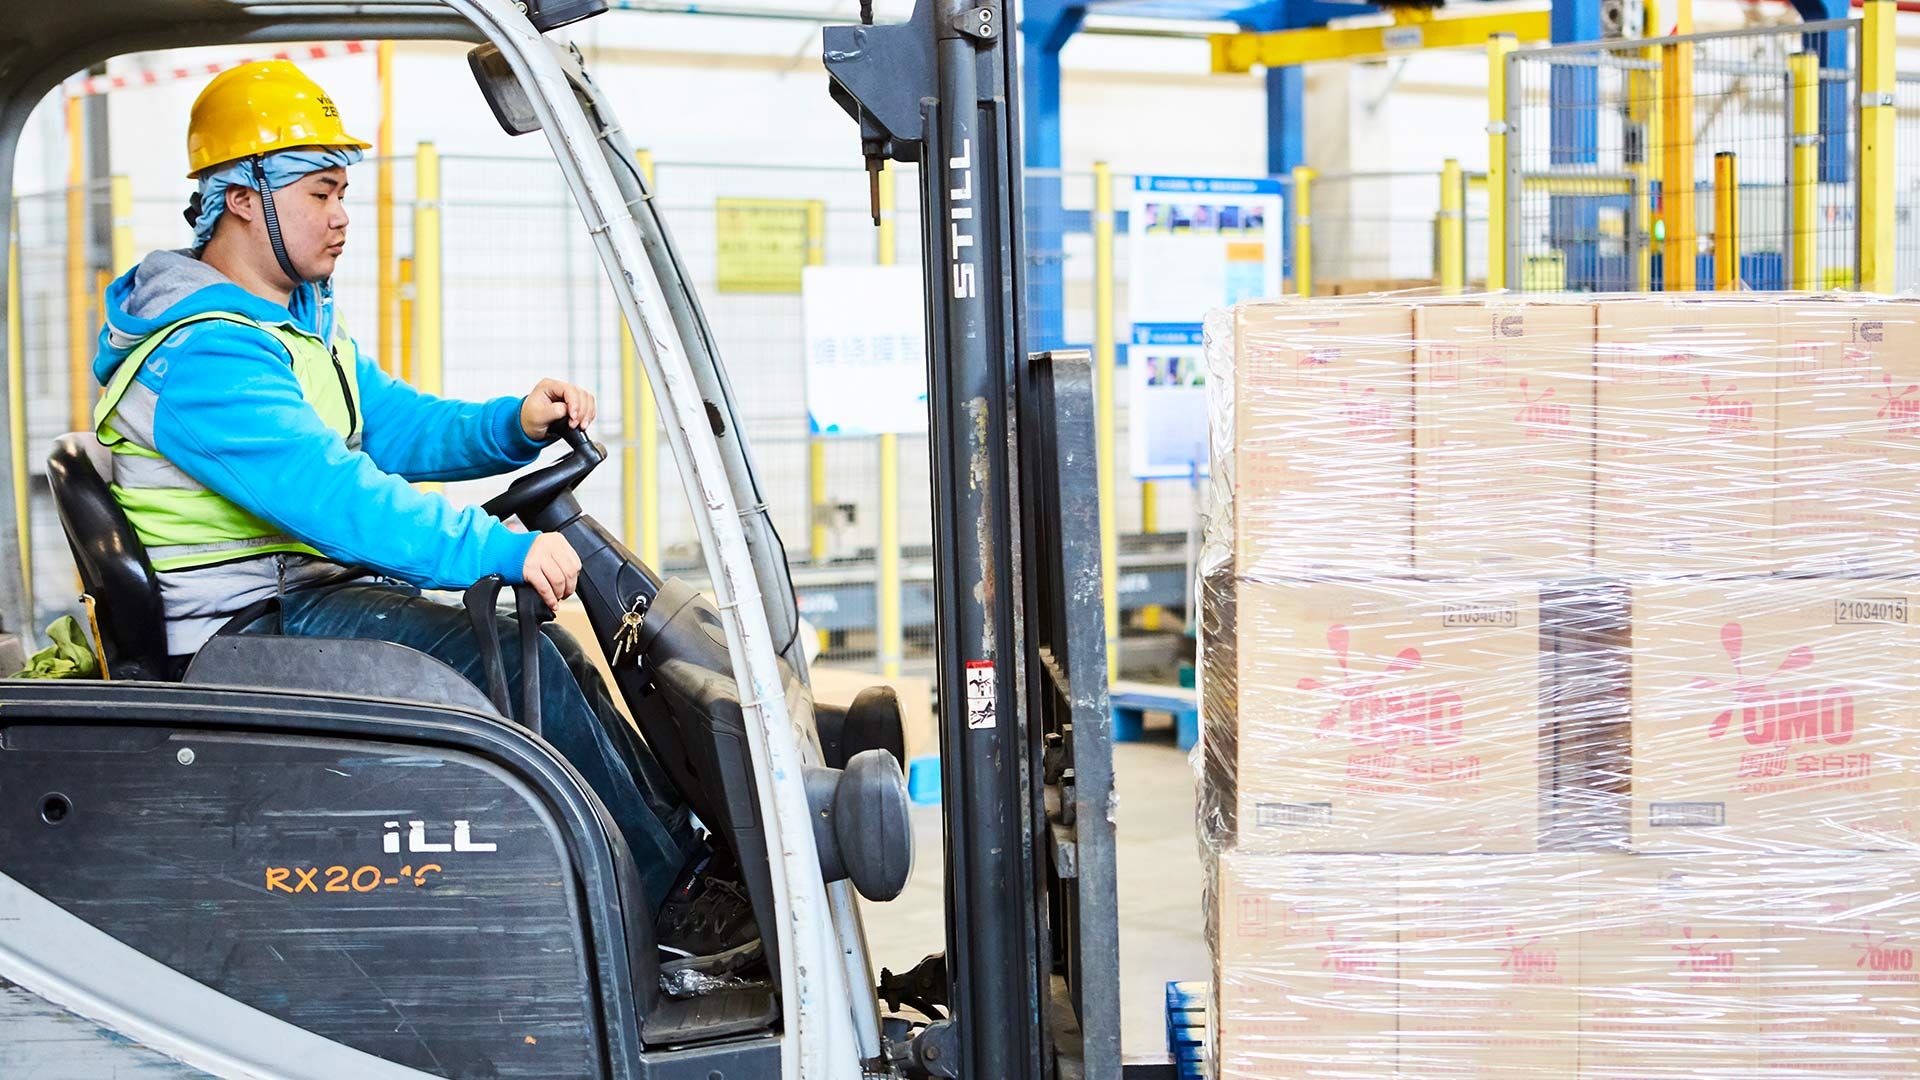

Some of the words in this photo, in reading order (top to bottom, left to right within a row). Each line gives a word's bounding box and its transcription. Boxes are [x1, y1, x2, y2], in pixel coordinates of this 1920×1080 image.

[949, 138, 975, 298] STILL
[1708, 400, 1753, 424] OMO
[1840, 602, 1903, 620] 21034015
[1349, 690, 1463, 746] OMO
[1743, 687, 1854, 745] OMO
[1795, 752, 1871, 779] 全自动
[1512, 951, 1557, 973] OMO
[1691, 951, 1734, 972] OMO
[1870, 949, 1913, 970] OMO
